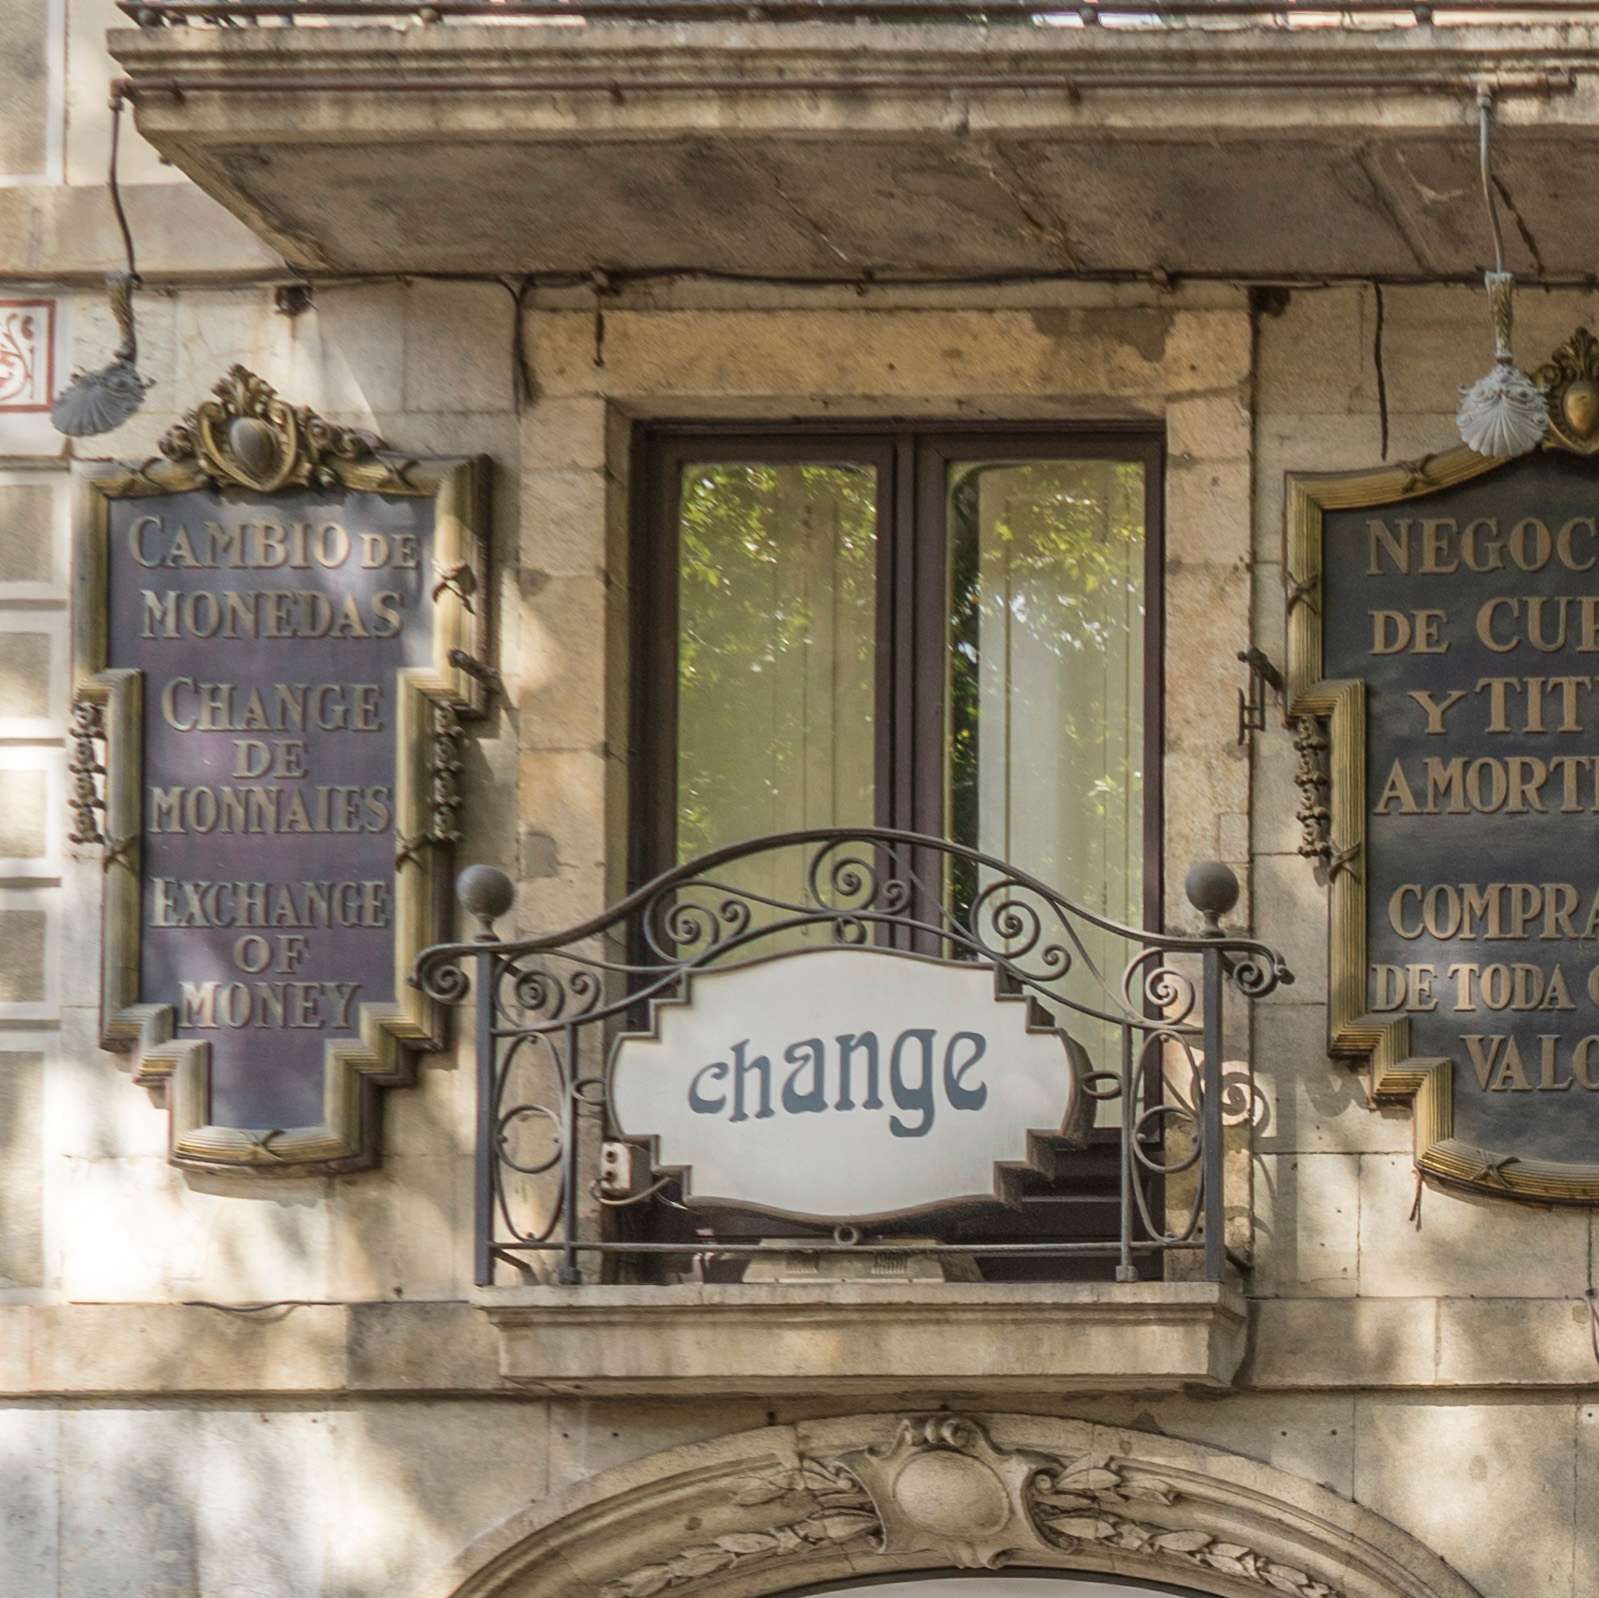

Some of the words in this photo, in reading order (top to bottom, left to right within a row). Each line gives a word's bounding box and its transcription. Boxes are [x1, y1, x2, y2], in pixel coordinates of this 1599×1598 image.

[127, 515, 350, 570] CAMBIO
[360, 533, 421, 570] DE
[139, 590, 403, 640] MONEDAS
[1370, 608, 1470, 656] DE
[162, 678, 385, 733] CHANGE
[1409, 689, 1469, 735] Y
[233, 739, 309, 779] DE
[148, 785, 393, 835] MONNAIES
[148, 877, 390, 928] EXCHANGE
[234, 935, 310, 975] OF
[178, 981, 362, 1029] MONEY
[1370, 964, 1438, 1012] DE
[1448, 962, 1569, 1012] TODA
[688, 1028, 988, 1138] change
